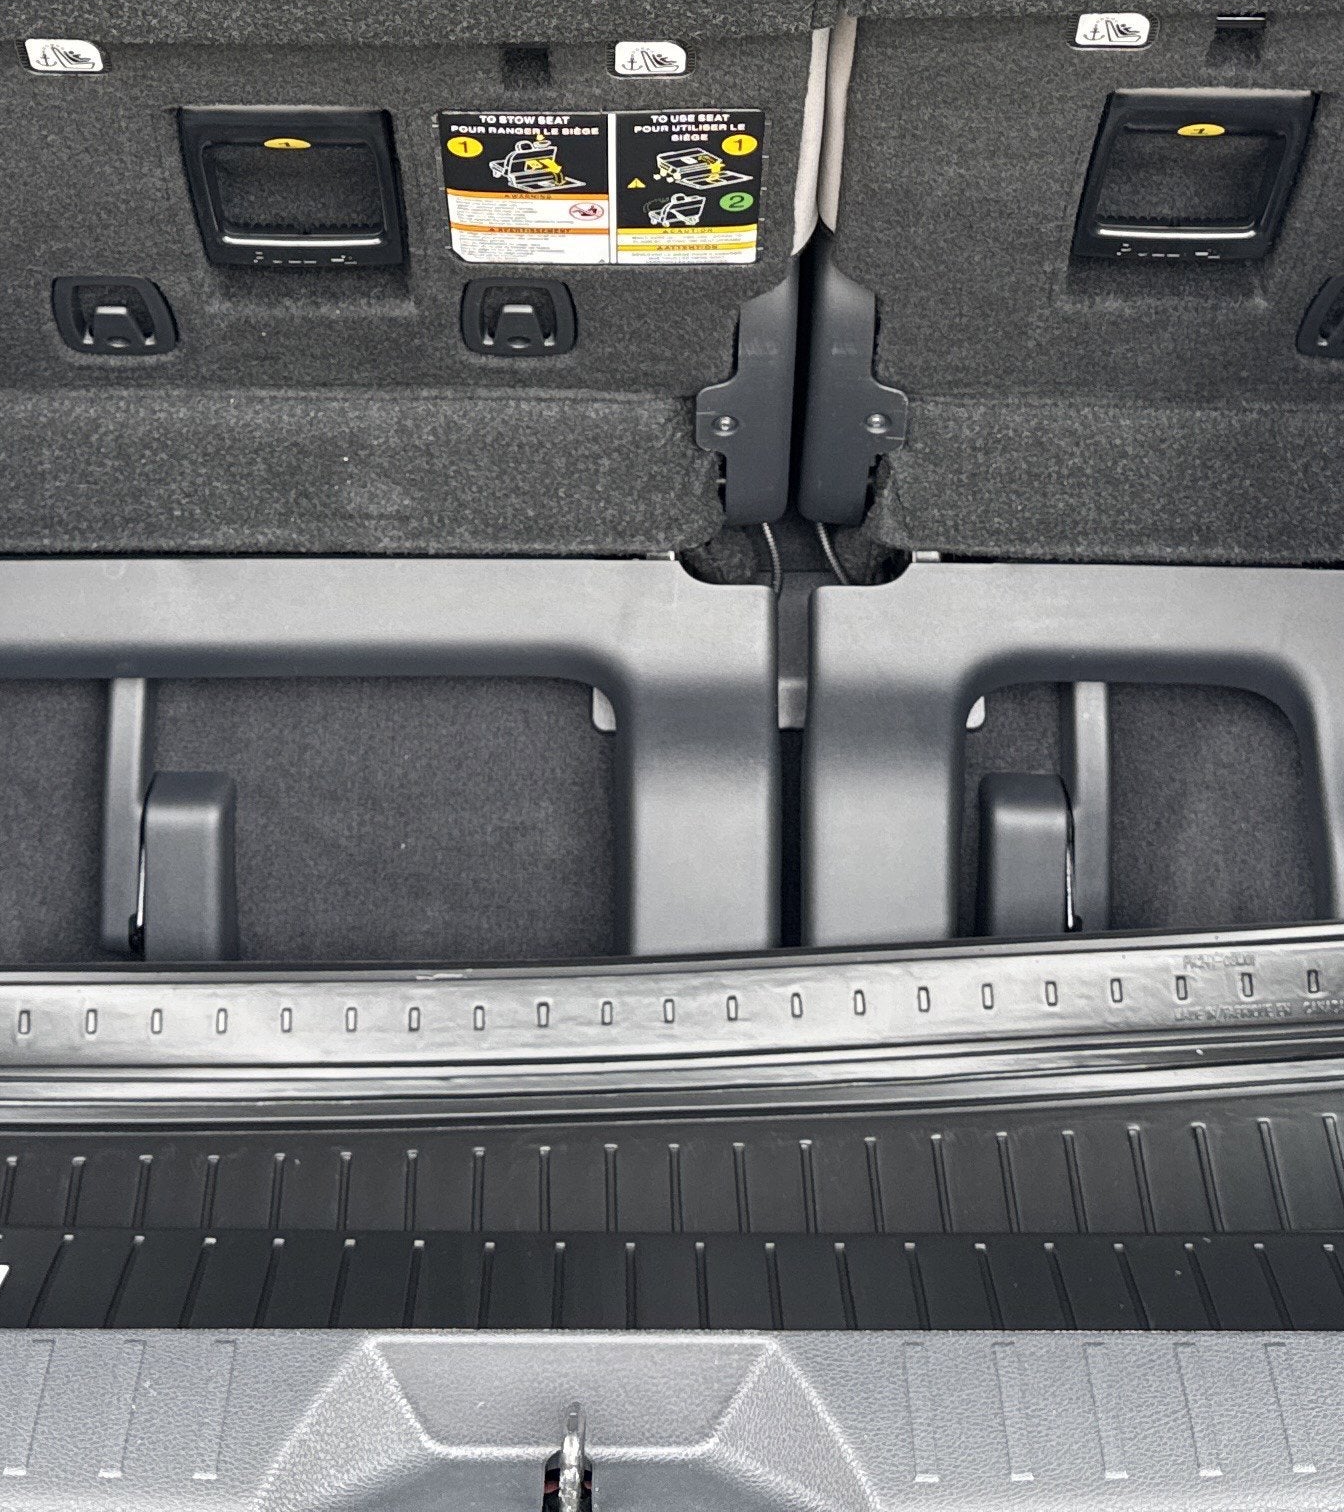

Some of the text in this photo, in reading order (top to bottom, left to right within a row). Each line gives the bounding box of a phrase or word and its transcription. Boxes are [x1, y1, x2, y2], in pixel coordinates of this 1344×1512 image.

[479, 115, 570, 125] TO STOW SEAT
[650, 113, 730, 124] TO USE SEAT
[450, 125, 486, 134] POUR
[488, 125, 540, 135] RANGER
[543, 127, 559, 135] LE
[634, 123, 746, 133] POUR UTILISER LE
[458, 140, 468, 153] 1
[733, 138, 743, 151] 1
[729, 195, 745, 208] 2
